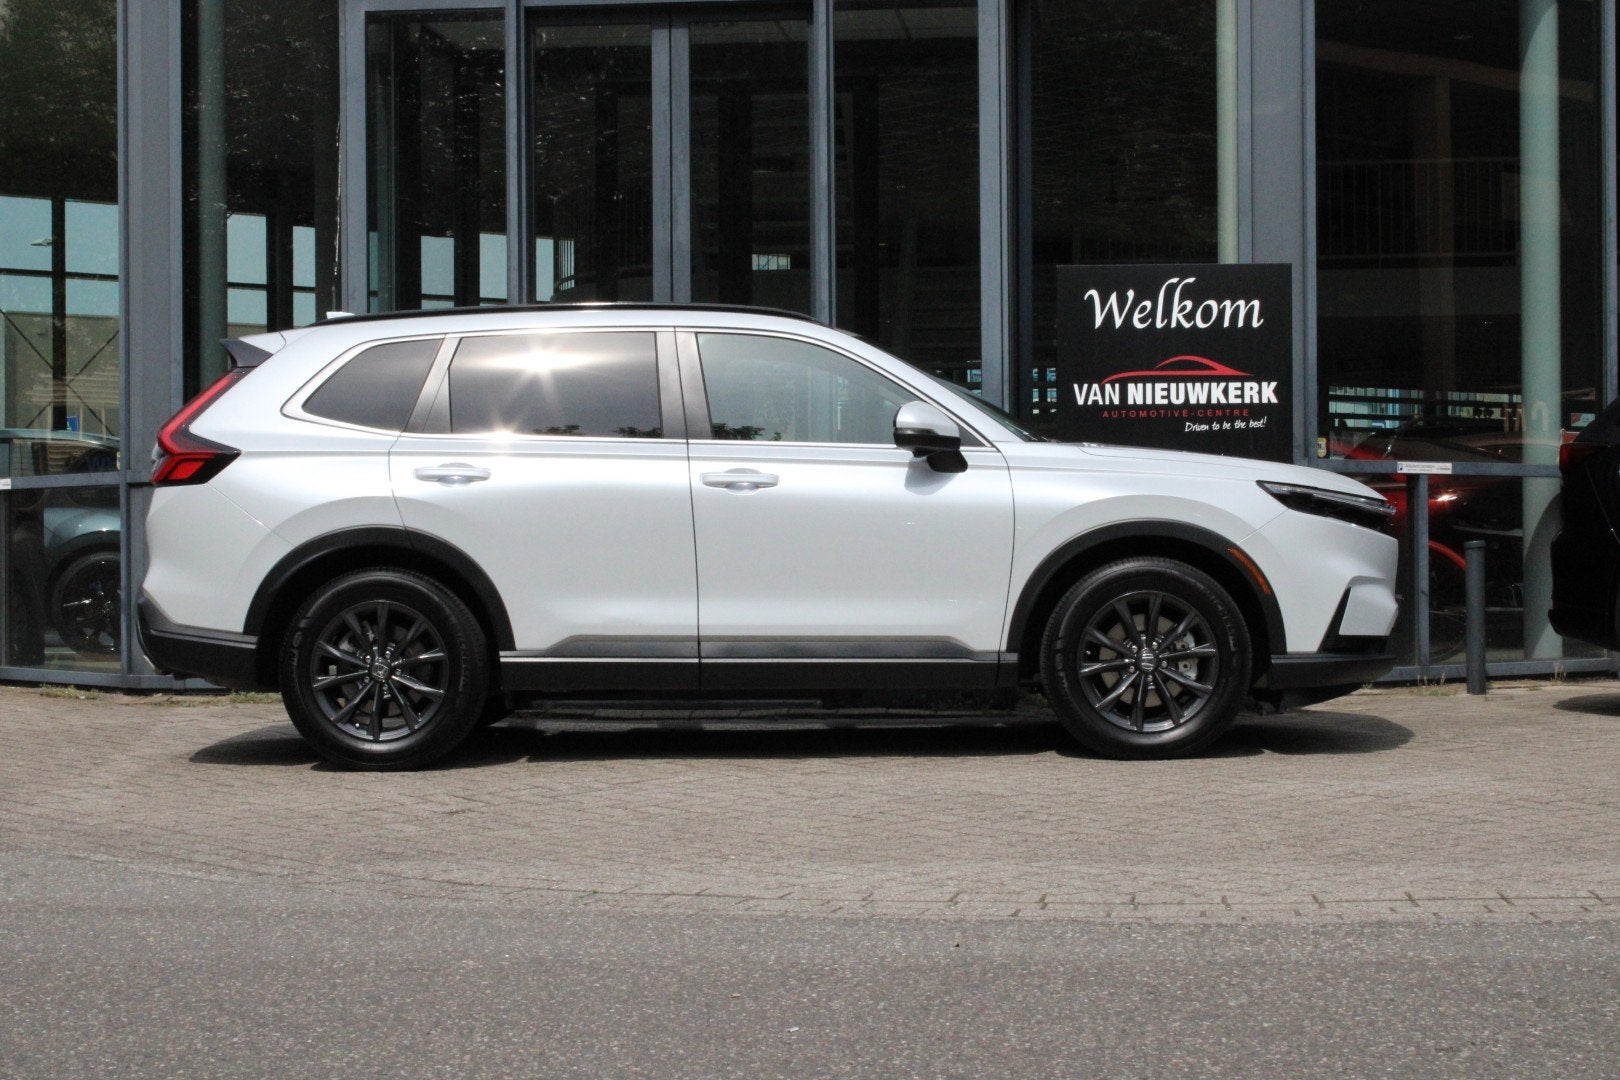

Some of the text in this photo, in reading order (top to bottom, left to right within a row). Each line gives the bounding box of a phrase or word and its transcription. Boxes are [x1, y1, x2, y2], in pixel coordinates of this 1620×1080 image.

[1083, 276, 1264, 330] Welkom
[1072, 381, 1279, 406] VAN NIEUWKERK
[1184, 415, 1268, 432] Driven to be the best!
